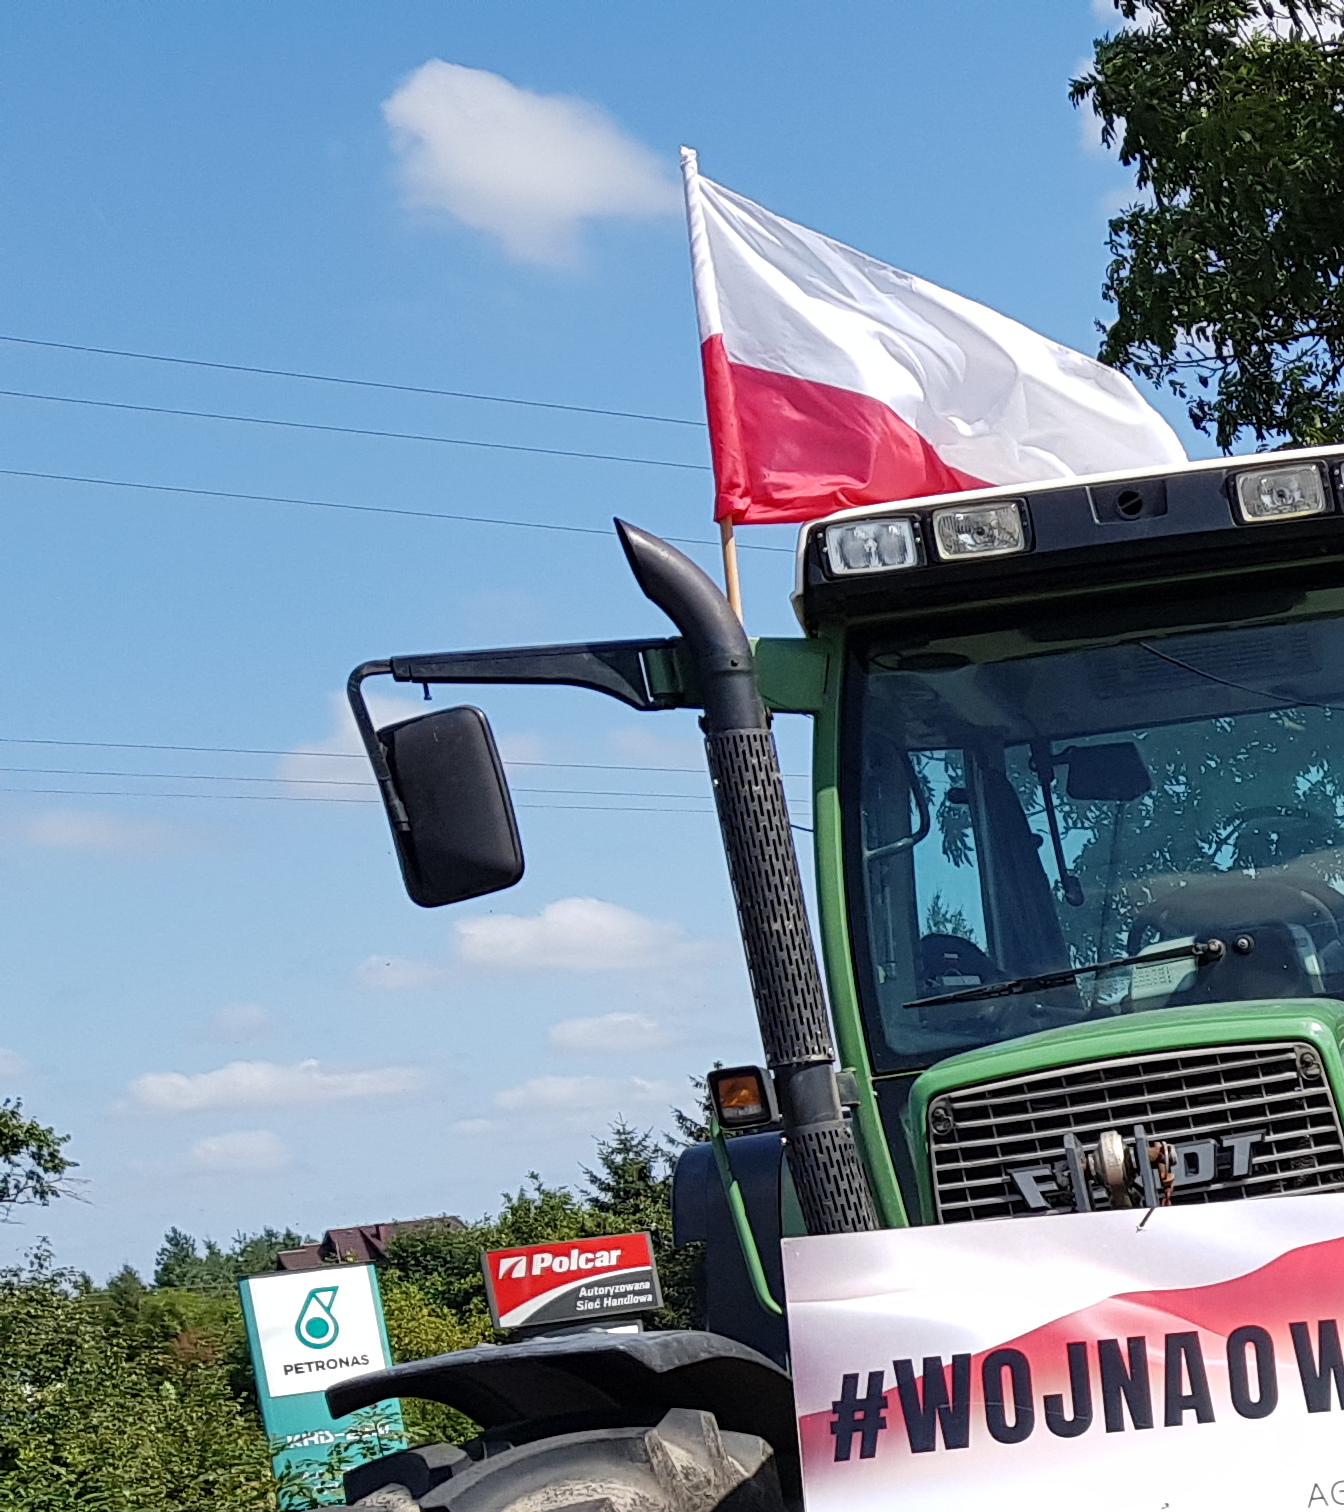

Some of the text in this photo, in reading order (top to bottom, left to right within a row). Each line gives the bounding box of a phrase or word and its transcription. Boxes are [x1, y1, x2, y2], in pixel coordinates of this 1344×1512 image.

[1006, 1129, 1267, 1209] FDT
[531, 1249, 622, 1276] Polcar
[578, 1281, 651, 1298] Autoryzowana
[576, 1293, 653, 1311] Sieć Handlowa
[283, 1354, 370, 1376] PETRONAS
